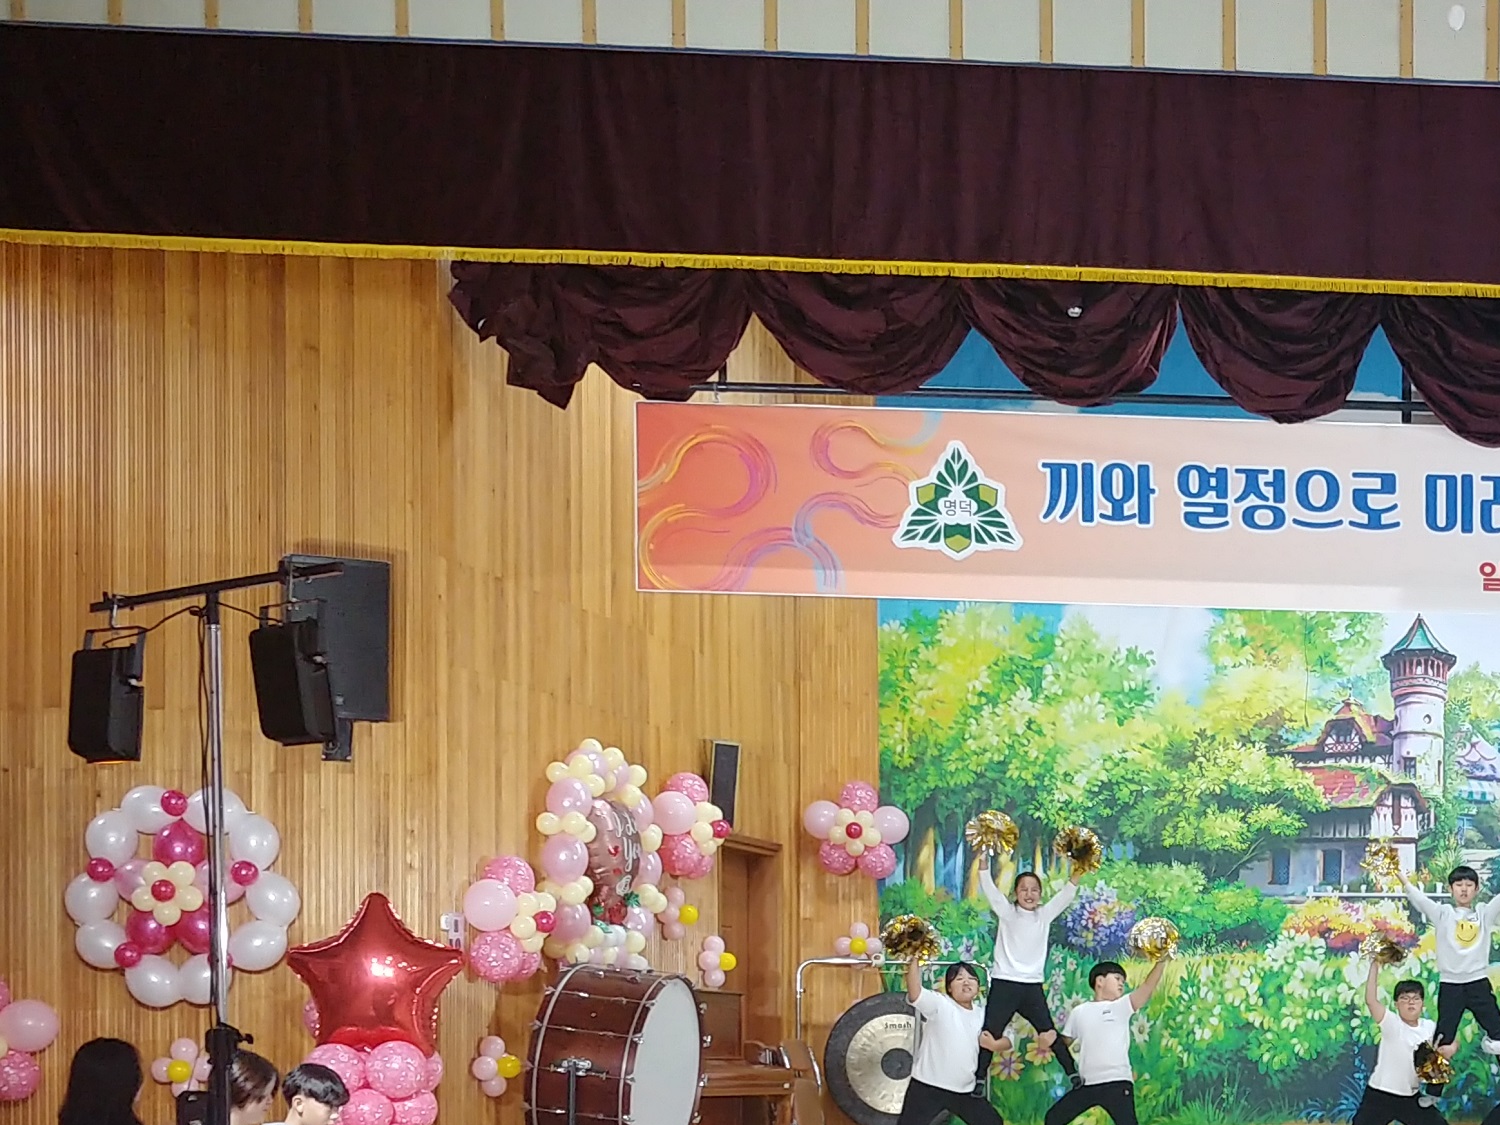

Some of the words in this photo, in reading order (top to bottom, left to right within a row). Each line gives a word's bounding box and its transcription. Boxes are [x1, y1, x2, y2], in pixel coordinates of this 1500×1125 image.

[943, 499, 972, 517] 명덕
[1042, 462, 1156, 525] 끼와
[1177, 464, 1400, 530] 열정으로
